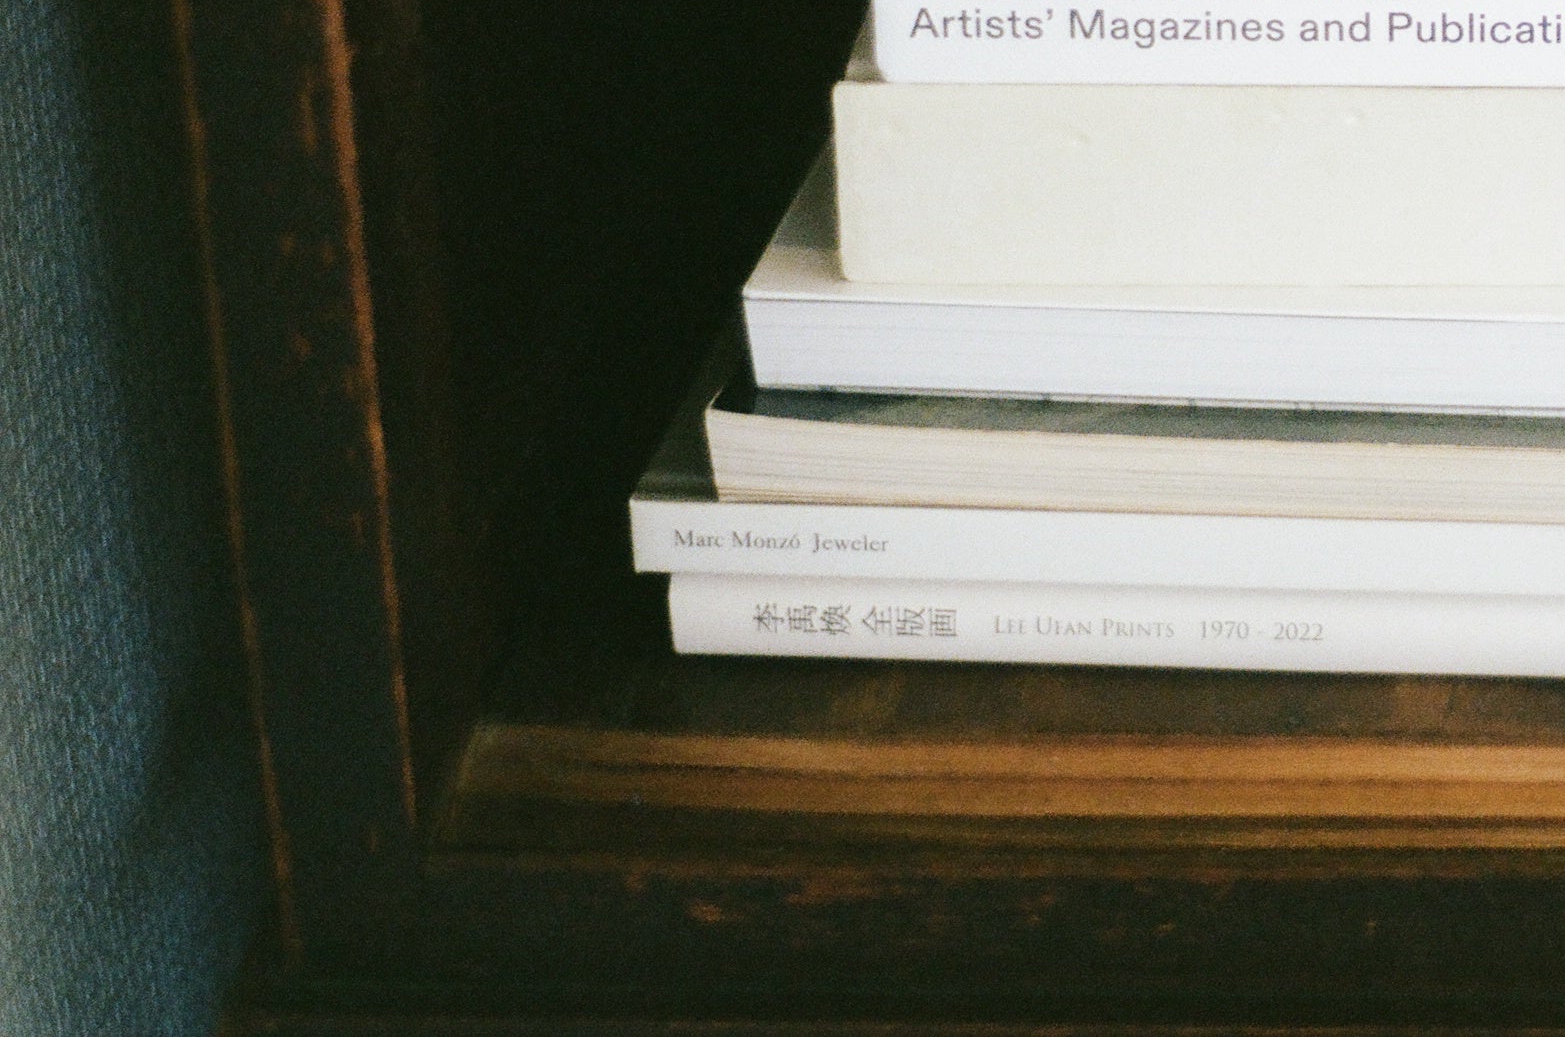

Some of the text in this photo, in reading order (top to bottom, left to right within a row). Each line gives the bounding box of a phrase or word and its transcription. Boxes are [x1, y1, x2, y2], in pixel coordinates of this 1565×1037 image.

[1068, 8, 1286, 50] Magazines
[1299, 12, 1372, 43] and
[674, 528, 890, 554] Marc Monzó Jeweler
[860, 605, 958, 638] 全版画
[1199, 619, 1250, 641] 1970
[1272, 621, 1324, 643] 2022
